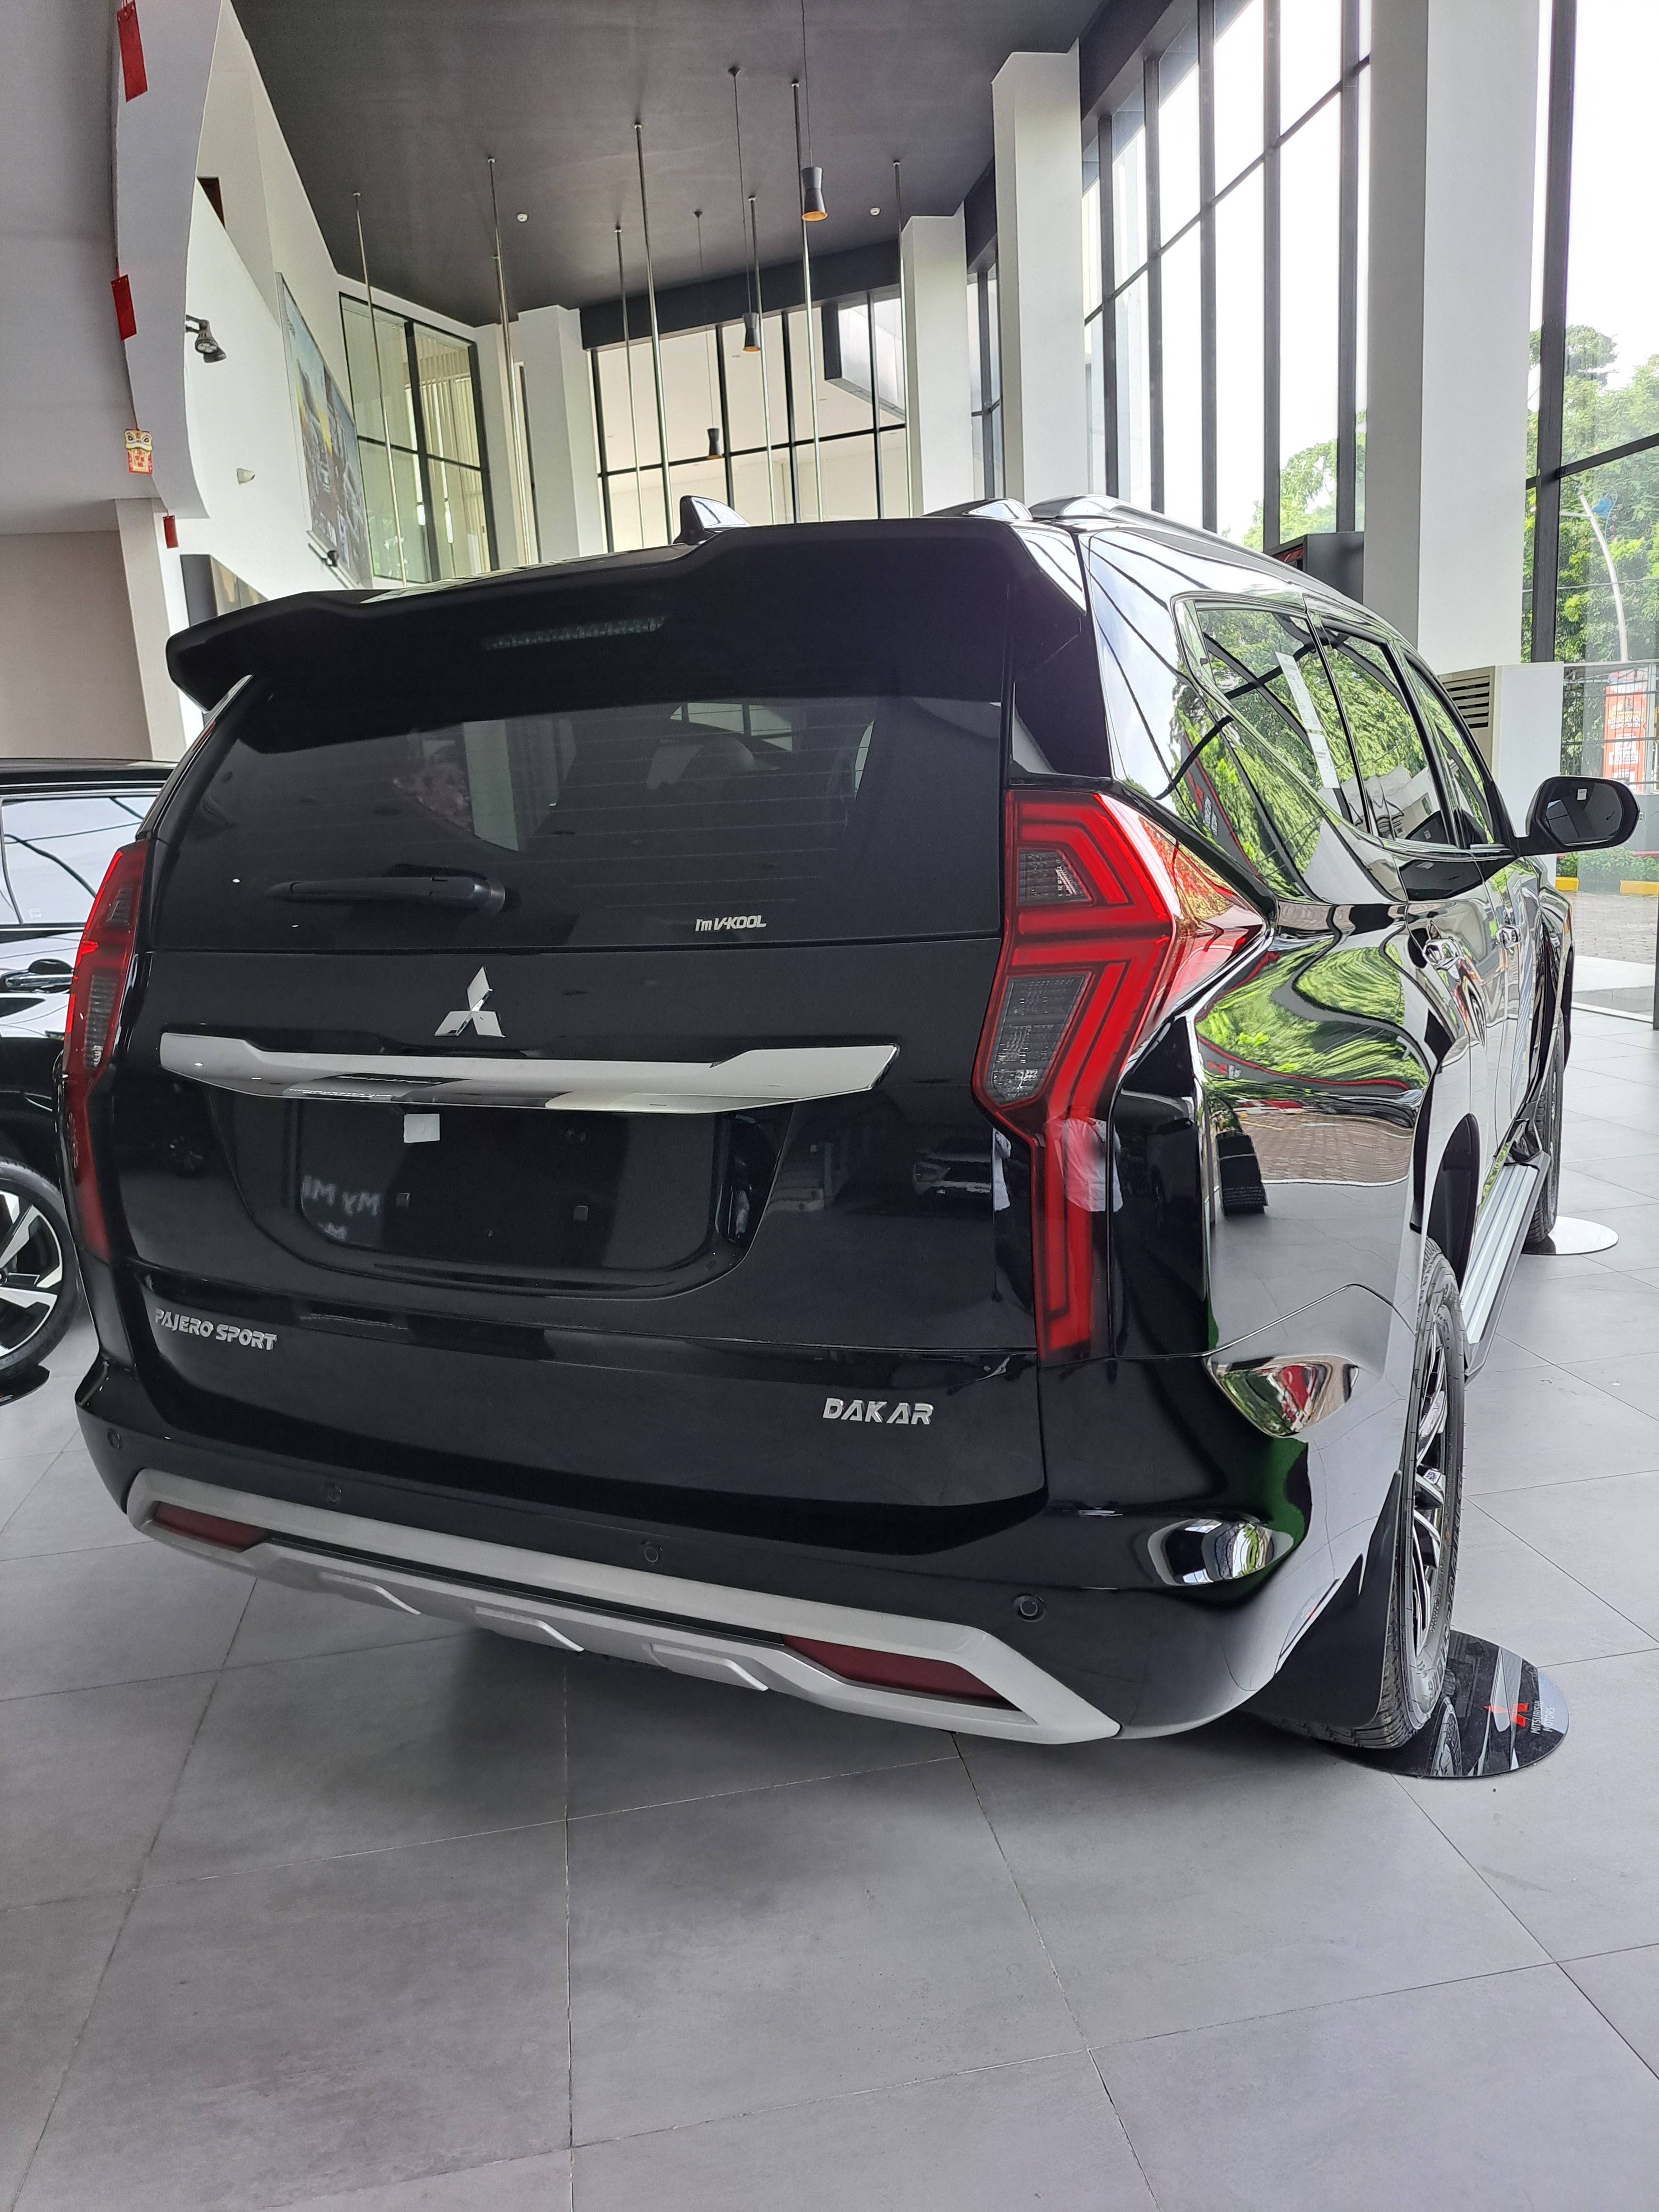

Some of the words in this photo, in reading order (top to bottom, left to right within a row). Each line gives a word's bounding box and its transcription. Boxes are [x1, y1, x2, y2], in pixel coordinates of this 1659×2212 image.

[695, 918, 713, 931] I'm
[714, 915, 767, 931] V-KOOL
[155, 1307, 214, 1338] PAJERO
[215, 1324, 277, 1350] SPORT
[822, 1398, 934, 1425] DAKAR
[1543, 1706, 1555, 1732] MOTORS
